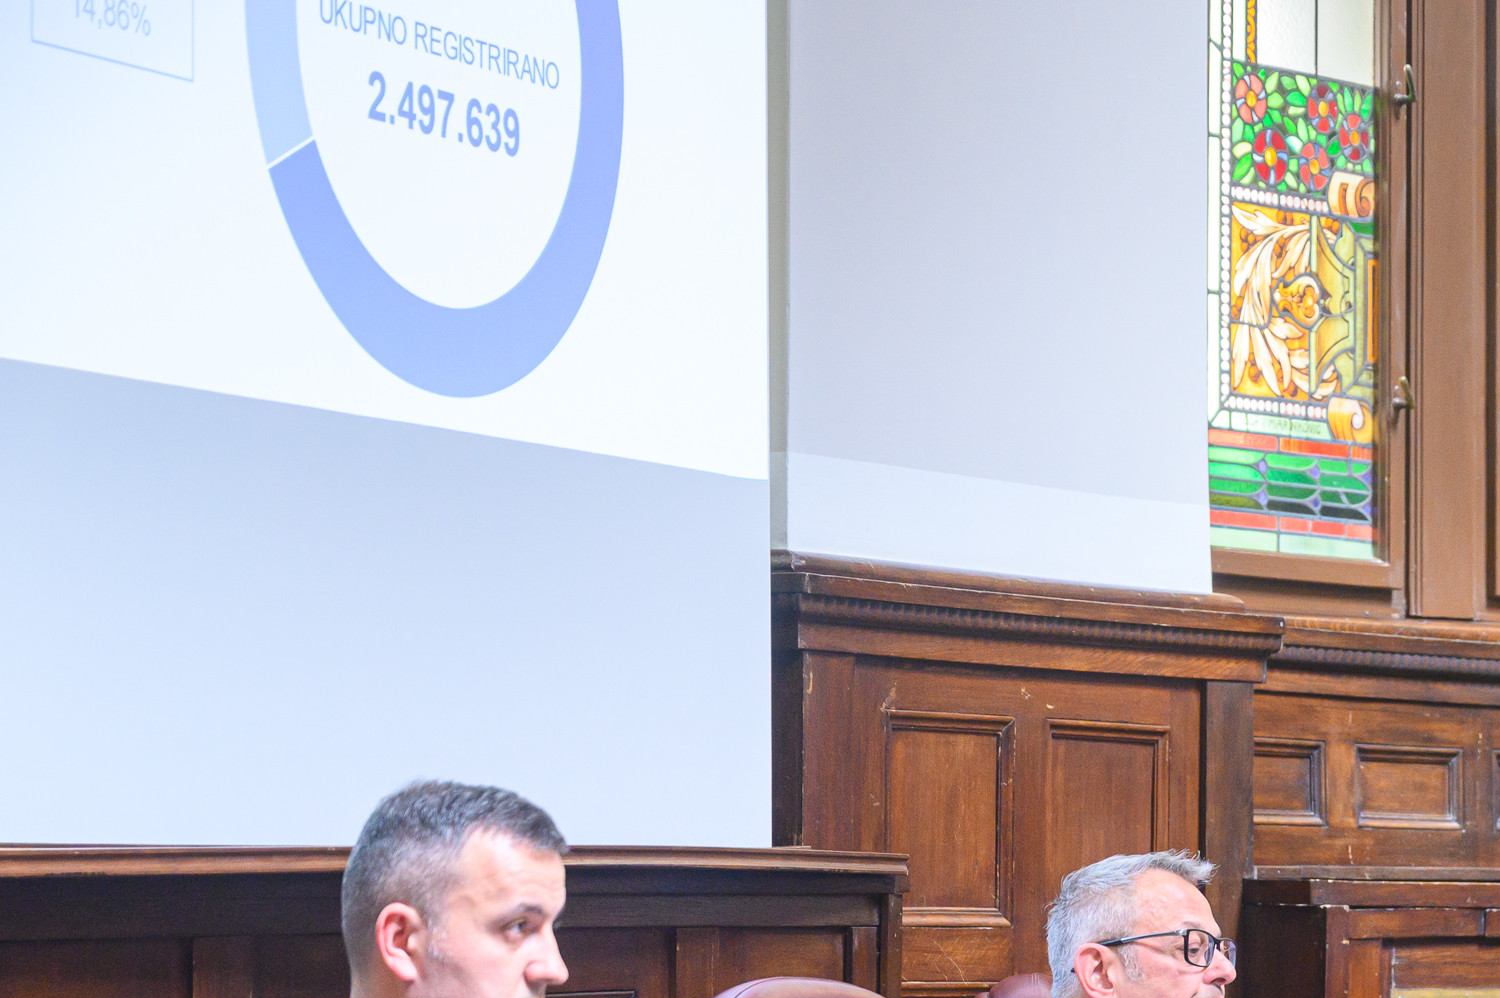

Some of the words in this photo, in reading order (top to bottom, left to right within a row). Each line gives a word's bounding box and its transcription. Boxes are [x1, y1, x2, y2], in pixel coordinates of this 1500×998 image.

[319, 0, 407, 45] UKUPNO
[414, 20, 560, 90] REGISTRIRANO
[367, 70, 520, 158] 2.497.639
